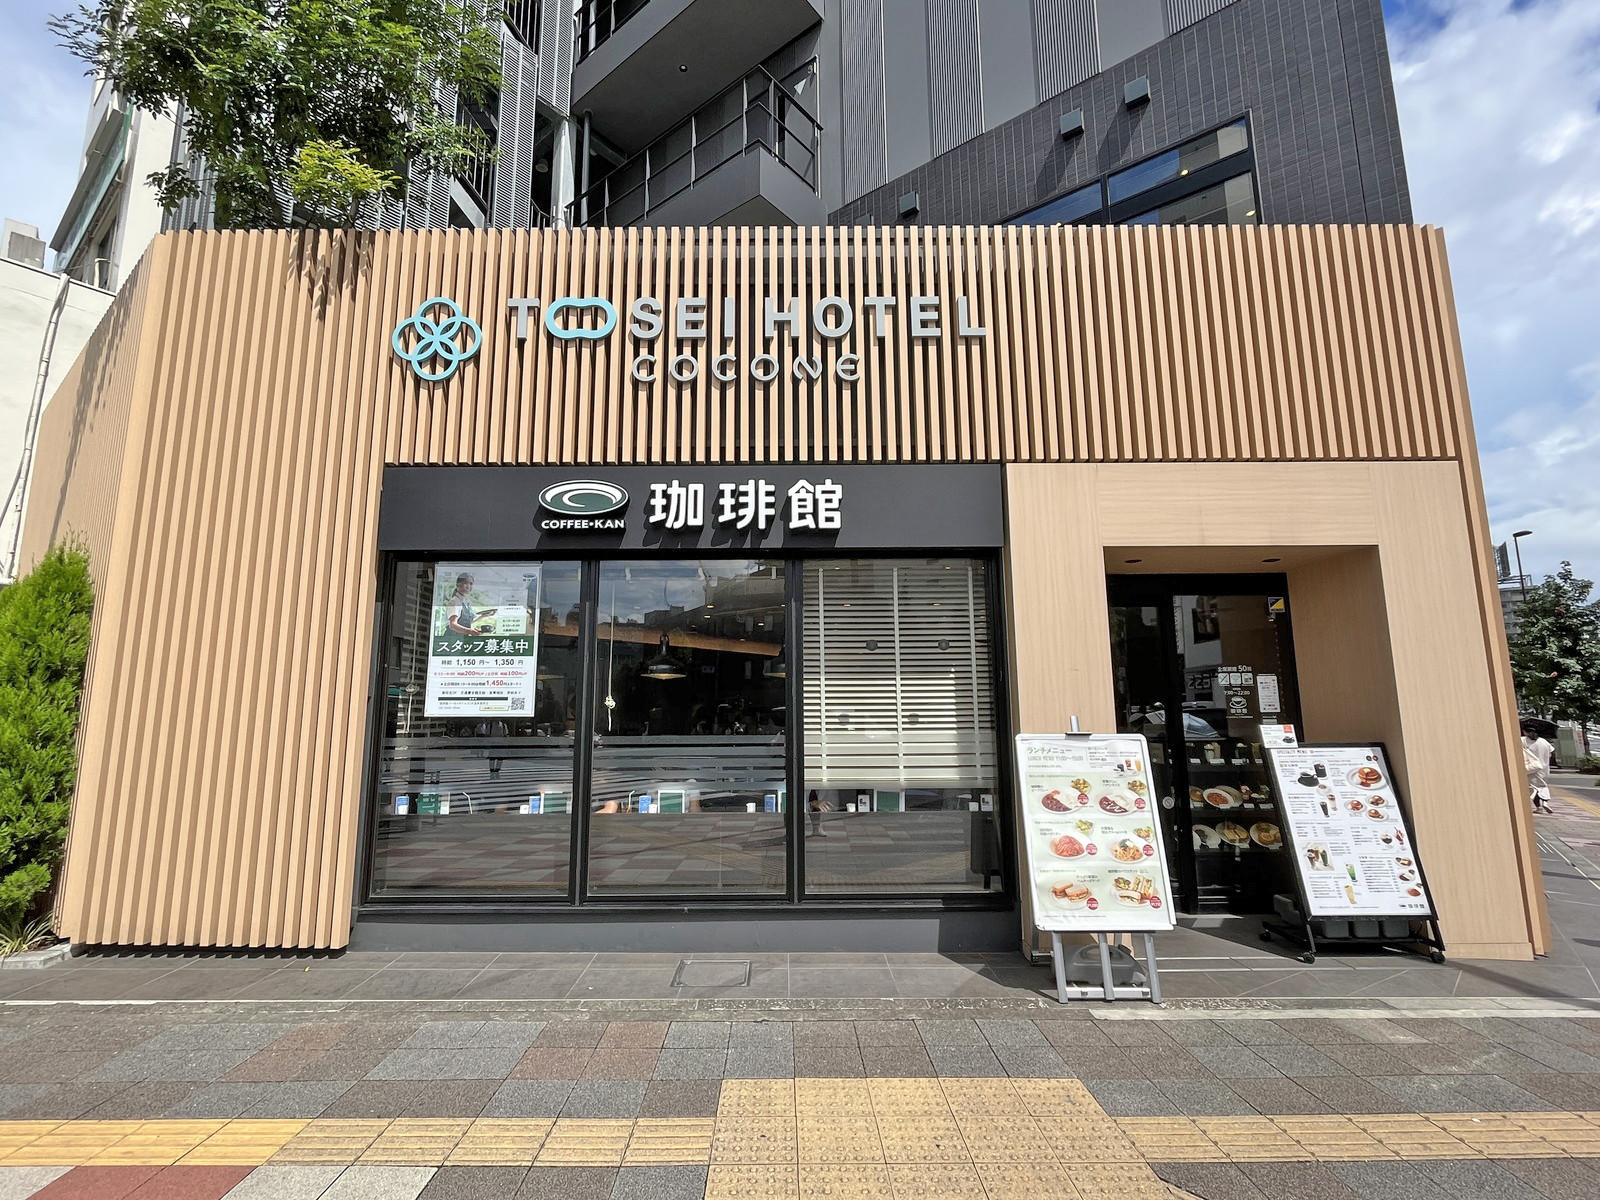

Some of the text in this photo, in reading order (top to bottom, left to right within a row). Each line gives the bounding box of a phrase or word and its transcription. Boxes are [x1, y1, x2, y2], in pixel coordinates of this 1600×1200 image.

[765, 296, 986, 339] HOTEL
[632, 354, 861, 382] COCONE
[649, 478, 843, 530] 珈琲館
[436, 638, 529, 654] スタッフ募集中
[456, 659, 476, 667] 1,150
[494, 659, 515, 667] 1,350
[1027, 747, 1073, 755] ランチメニュー
